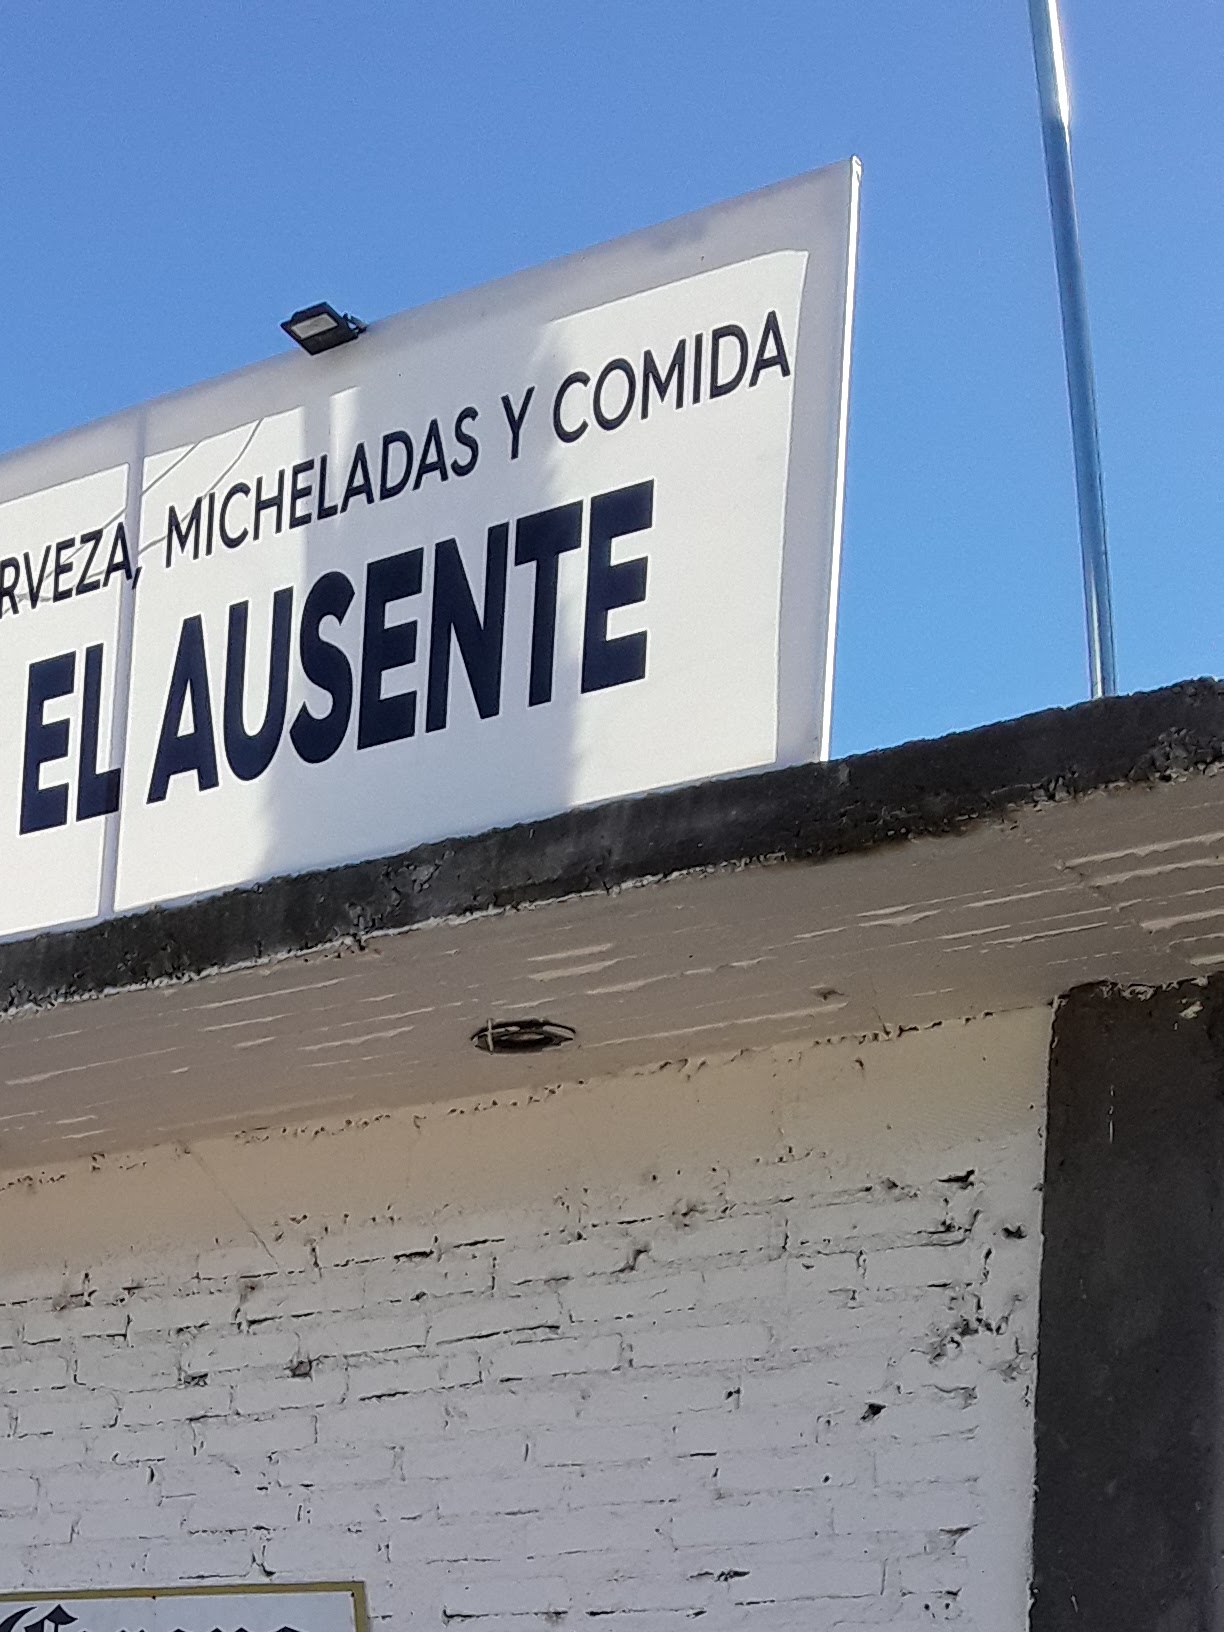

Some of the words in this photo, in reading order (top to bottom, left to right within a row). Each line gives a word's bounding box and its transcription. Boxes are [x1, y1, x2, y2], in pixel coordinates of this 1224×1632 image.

[166, 406, 480, 569] MICHELADAS
[502, 386, 536, 460] Y
[552, 311, 791, 444] COMIDA
[20, 642, 121, 834] EL
[146, 480, 655, 805] AUSENTE
